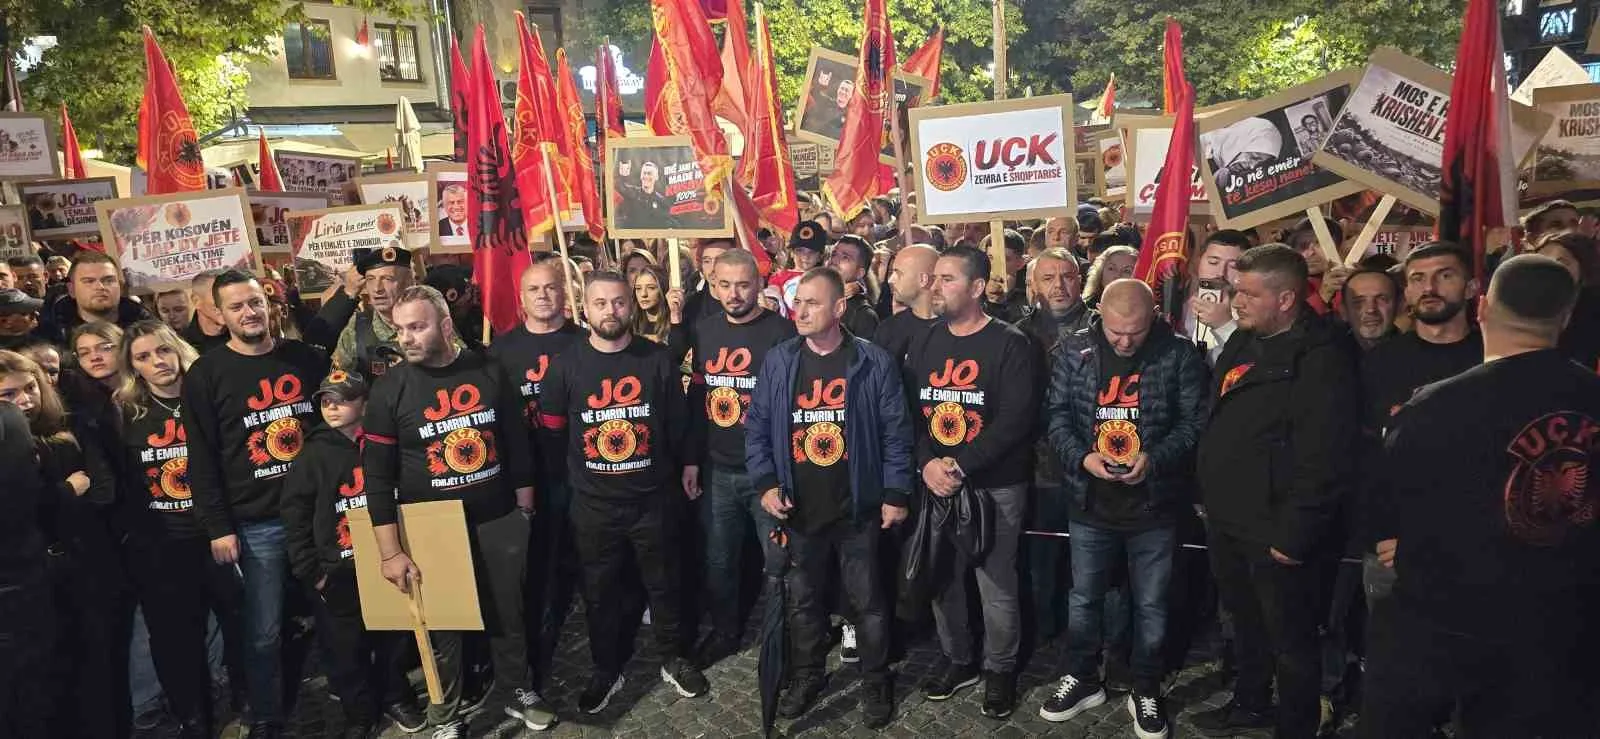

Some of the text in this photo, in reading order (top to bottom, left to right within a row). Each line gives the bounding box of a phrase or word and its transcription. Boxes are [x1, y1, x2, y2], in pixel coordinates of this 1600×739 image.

[1393, 81, 1429, 107] MOS
[1427, 96, 1441, 112] E
[1371, 92, 1436, 136] KRUSHËN
[975, 131, 1058, 171] UÇK
[974, 167, 1062, 185] ZEMRA E SHQIPTARISË
[1225, 157, 1301, 193] Jo në emër
[165, 218, 231, 241] KOSOVËN
[314, 220, 344, 240] Liria
[705, 347, 752, 374] JO
[929, 359, 979, 388] JO
[247, 374, 302, 411] JO
[424, 383, 481, 421] JO
[588, 375, 642, 409] JO
[798, 378, 847, 409] JO
[920, 386, 985, 406] NË EMRIN TONË
[243, 412, 259, 429] NË
[260, 403, 292, 424] EMRIN
[418, 408, 497, 440] NË EMRIN TONË
[596, 405, 627, 421] EMRIN
[628, 402, 651, 418] TONË
[804, 410, 834, 422] EMRIN
[141, 447, 155, 463] NË
